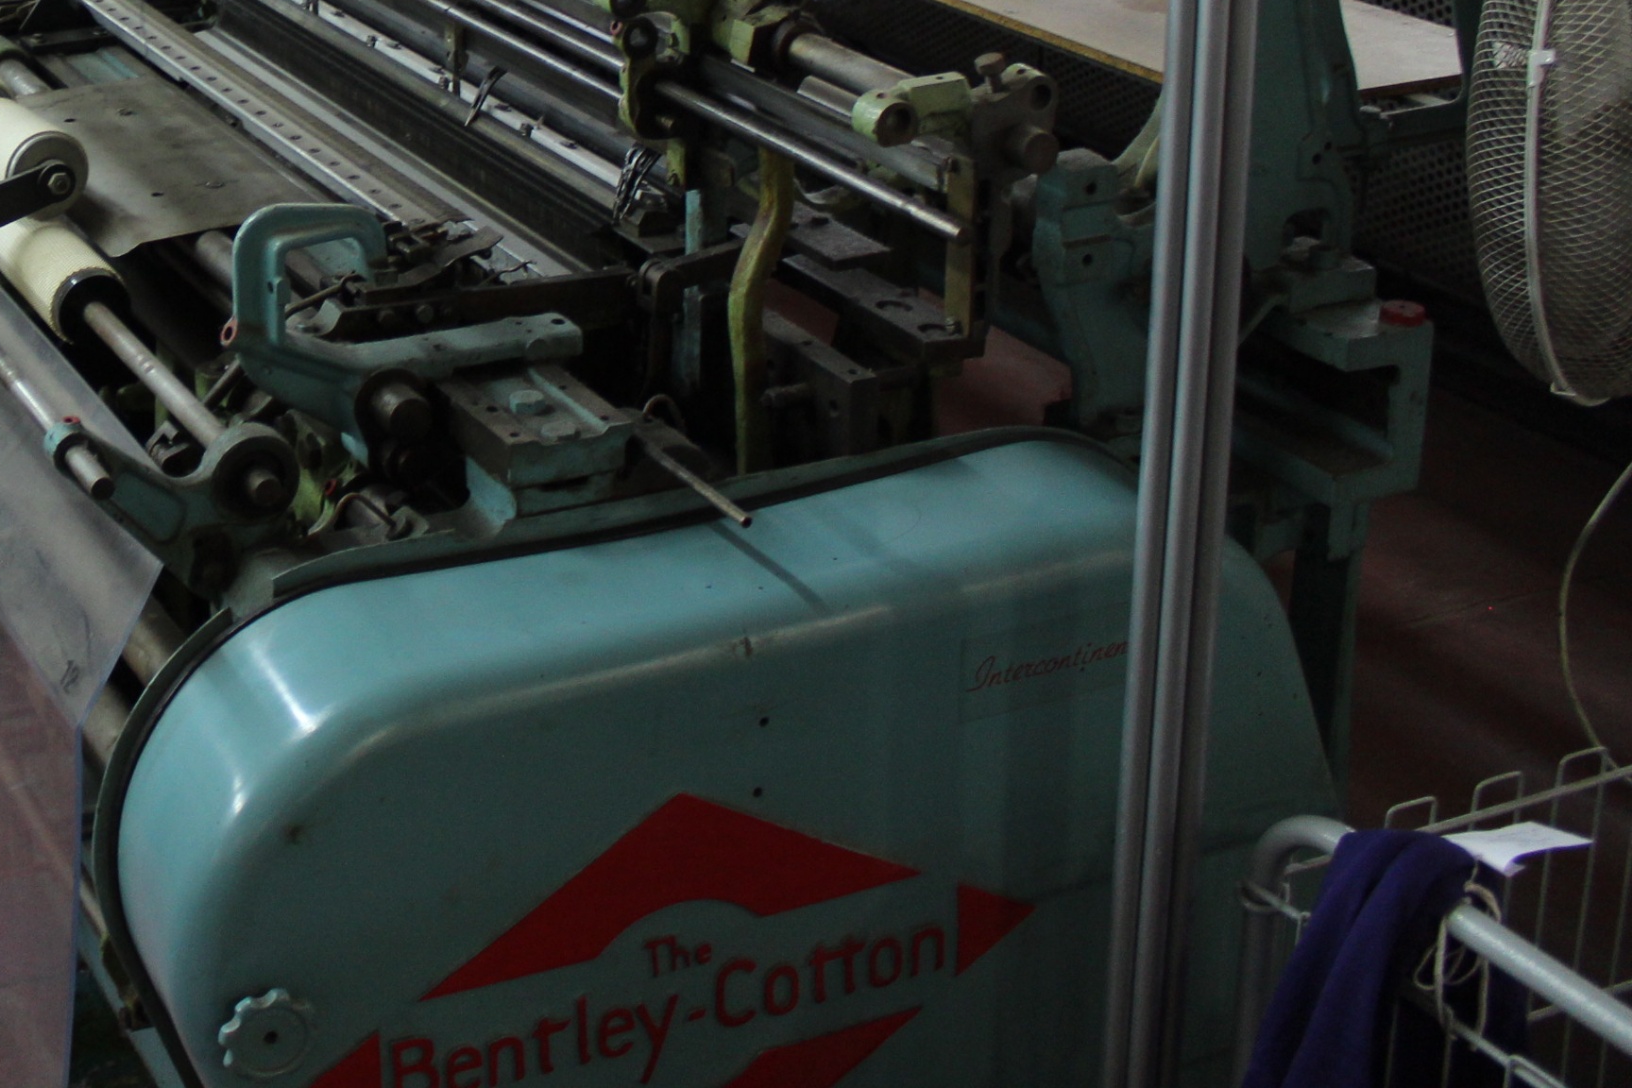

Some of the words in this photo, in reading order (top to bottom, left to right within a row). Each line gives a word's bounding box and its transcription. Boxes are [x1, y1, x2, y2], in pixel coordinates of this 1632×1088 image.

[965, 640, 1129, 693] Intercontinen
[643, 934, 714, 979] The
[390, 923, 947, 1088] Bentley-Cotton
